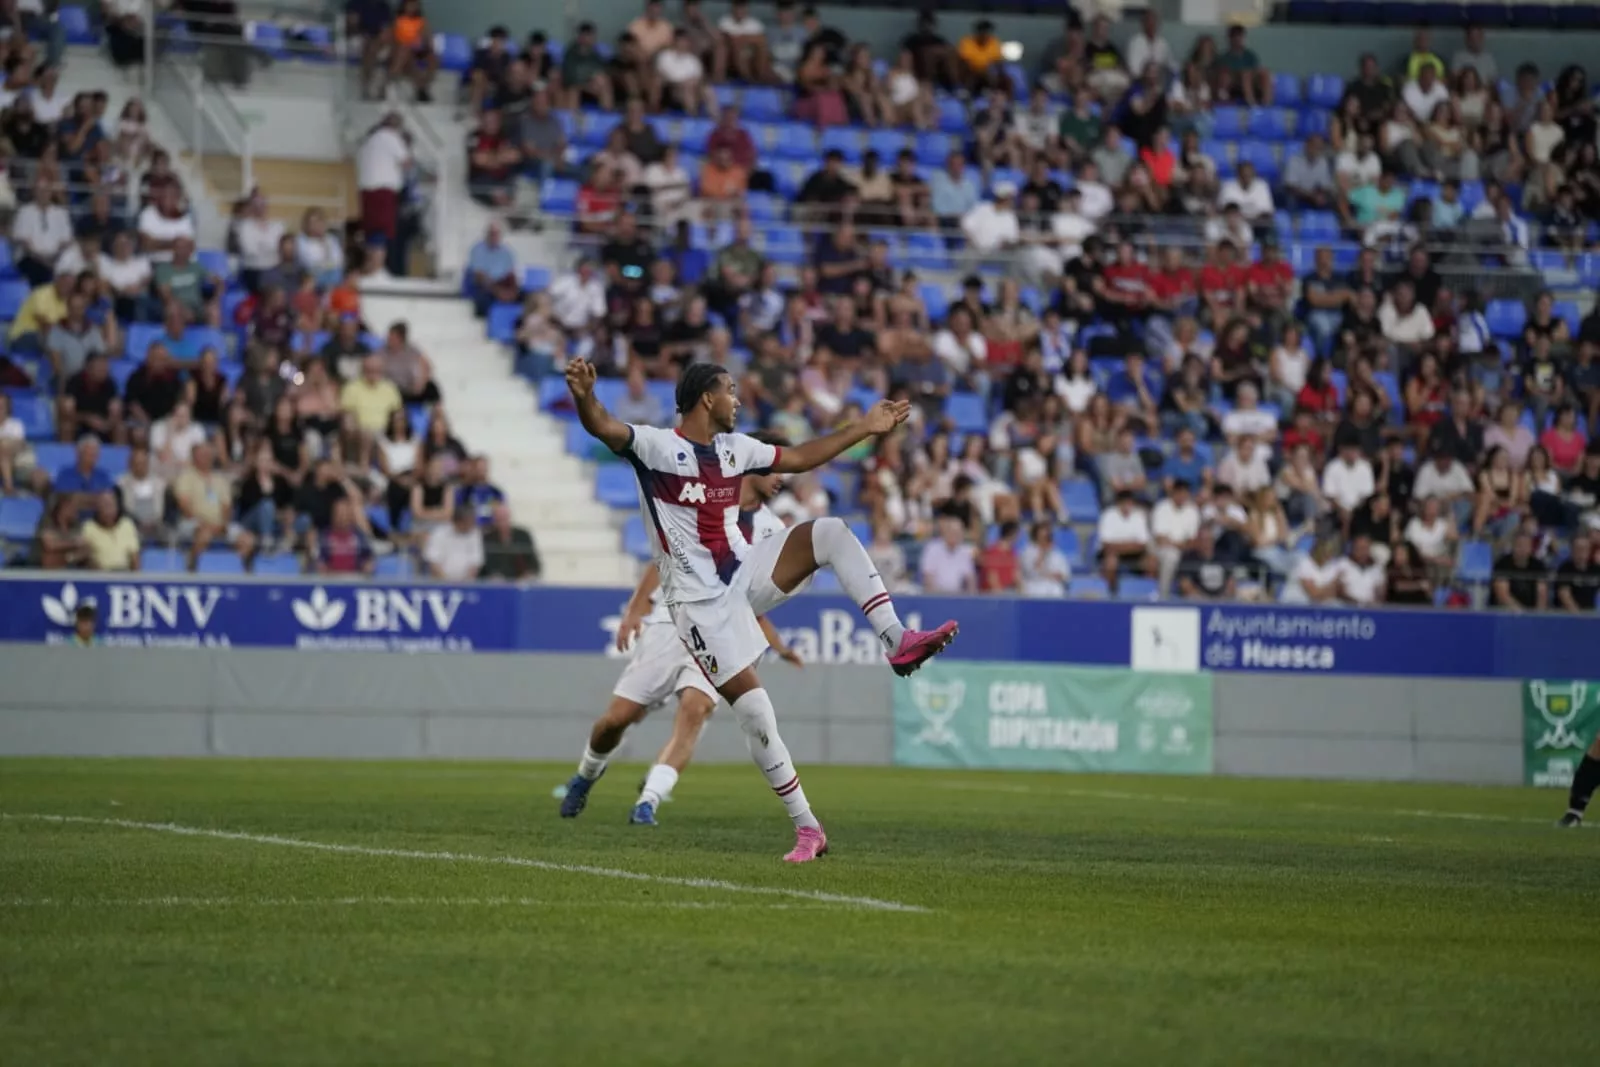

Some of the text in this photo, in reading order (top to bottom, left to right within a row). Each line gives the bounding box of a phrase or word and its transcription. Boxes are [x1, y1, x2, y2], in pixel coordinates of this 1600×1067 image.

[106, 584, 222, 629] BNV
[354, 588, 465, 632] BNV
[689, 625, 707, 652] 4
[1206, 607, 1376, 641] Ayuntamiento
[1204, 638, 1335, 669] de Huesca
[988, 682, 1047, 714] COPA
